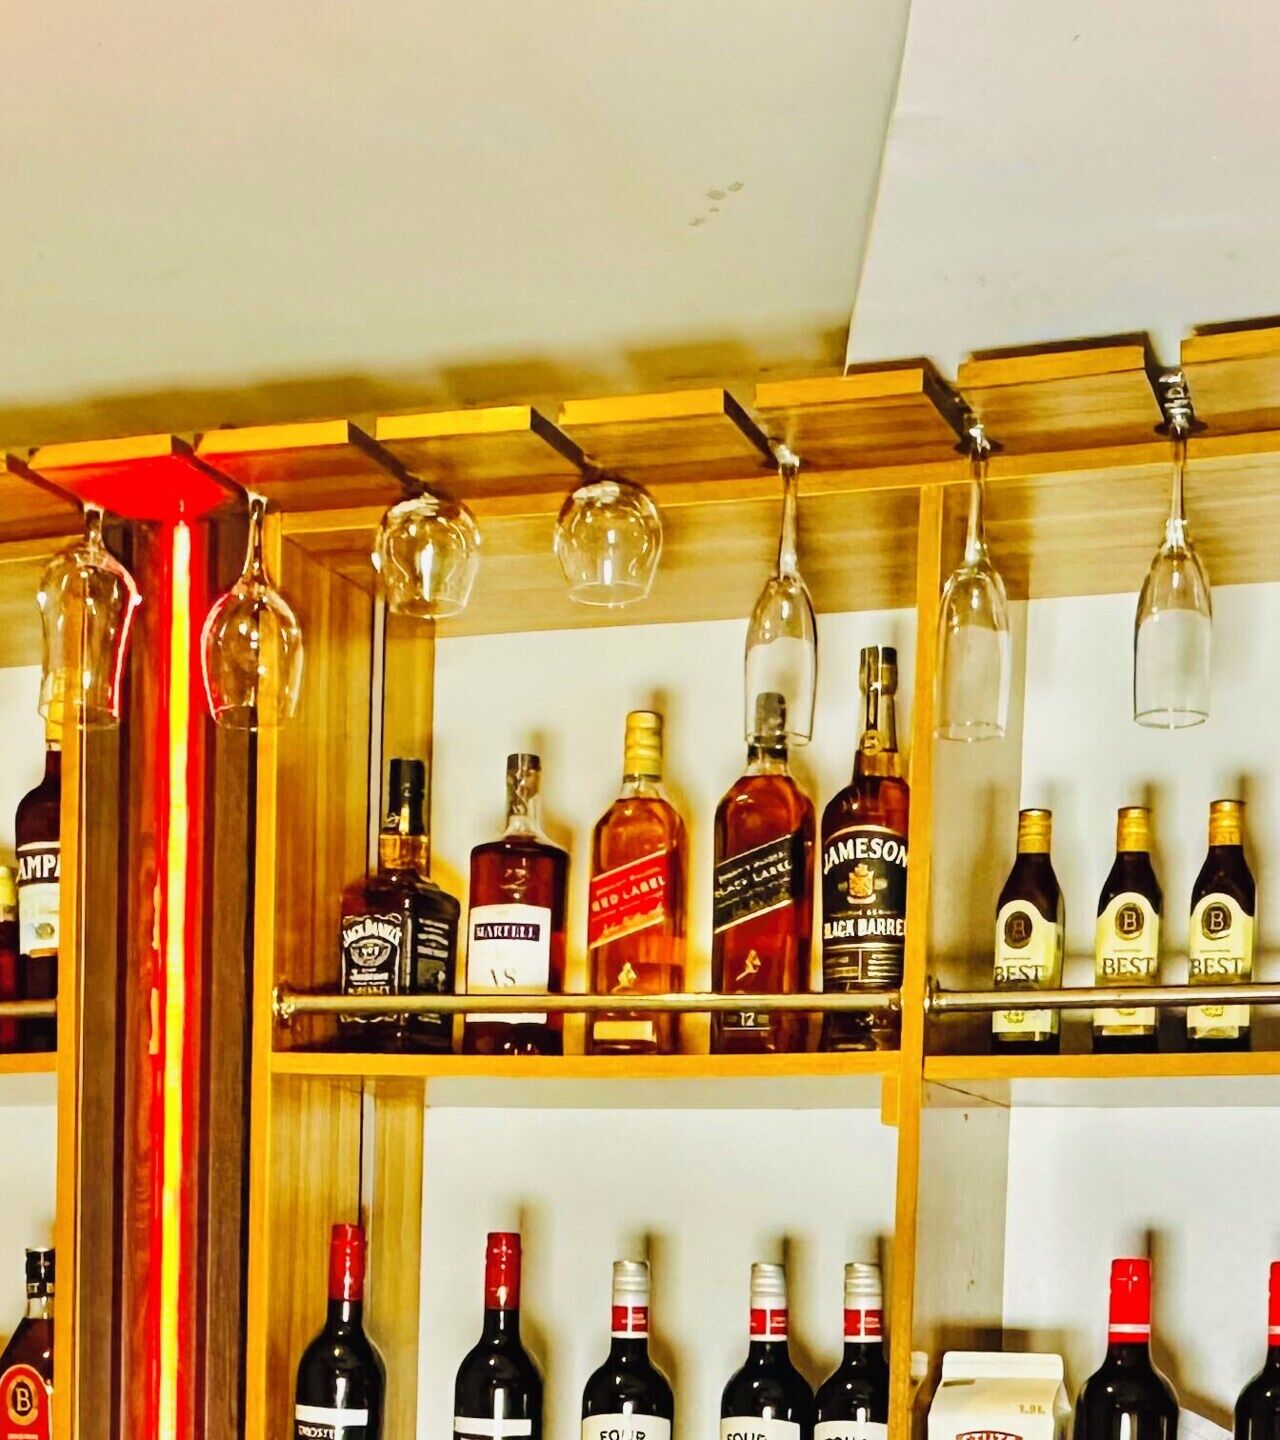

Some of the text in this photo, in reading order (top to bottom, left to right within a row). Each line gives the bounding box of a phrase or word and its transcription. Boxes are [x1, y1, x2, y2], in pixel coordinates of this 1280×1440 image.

[823, 838, 907, 875] JAMESON
[1102, 957, 1156, 975] BEST
[1189, 957, 1244, 975] BEST
[740, 1012, 755, 1026] 12
[17, 1388, 31, 1411] B
